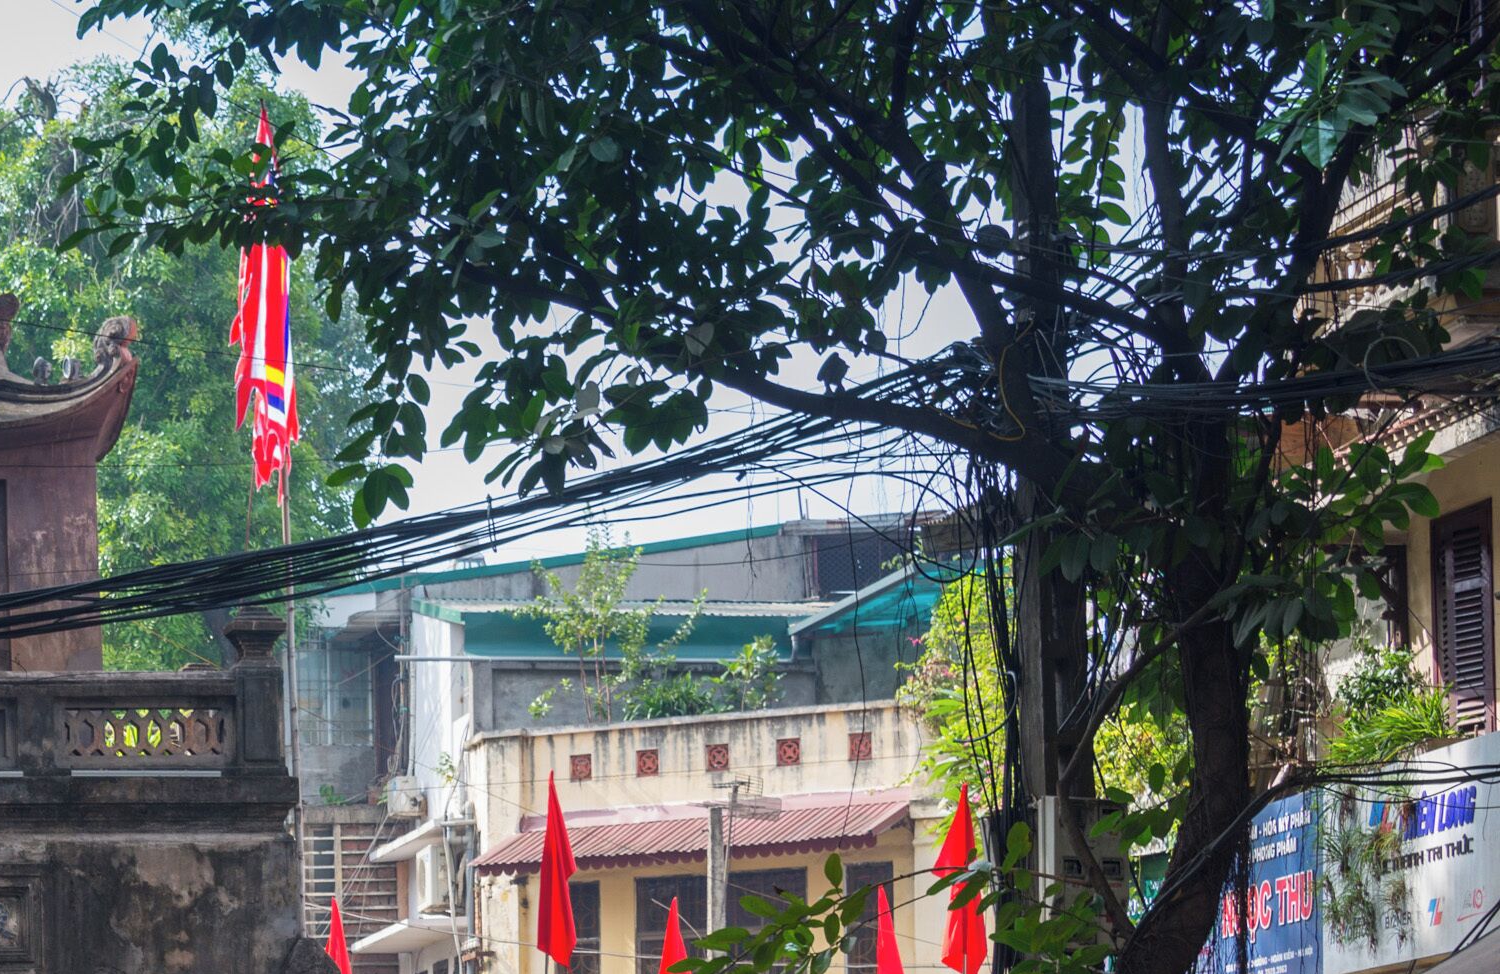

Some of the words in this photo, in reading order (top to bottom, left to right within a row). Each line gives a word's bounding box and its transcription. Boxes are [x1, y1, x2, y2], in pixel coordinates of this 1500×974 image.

[1438, 786, 1477, 832] LONG
[1426, 846, 1442, 862] TRI
[1275, 869, 1313, 926] THU
